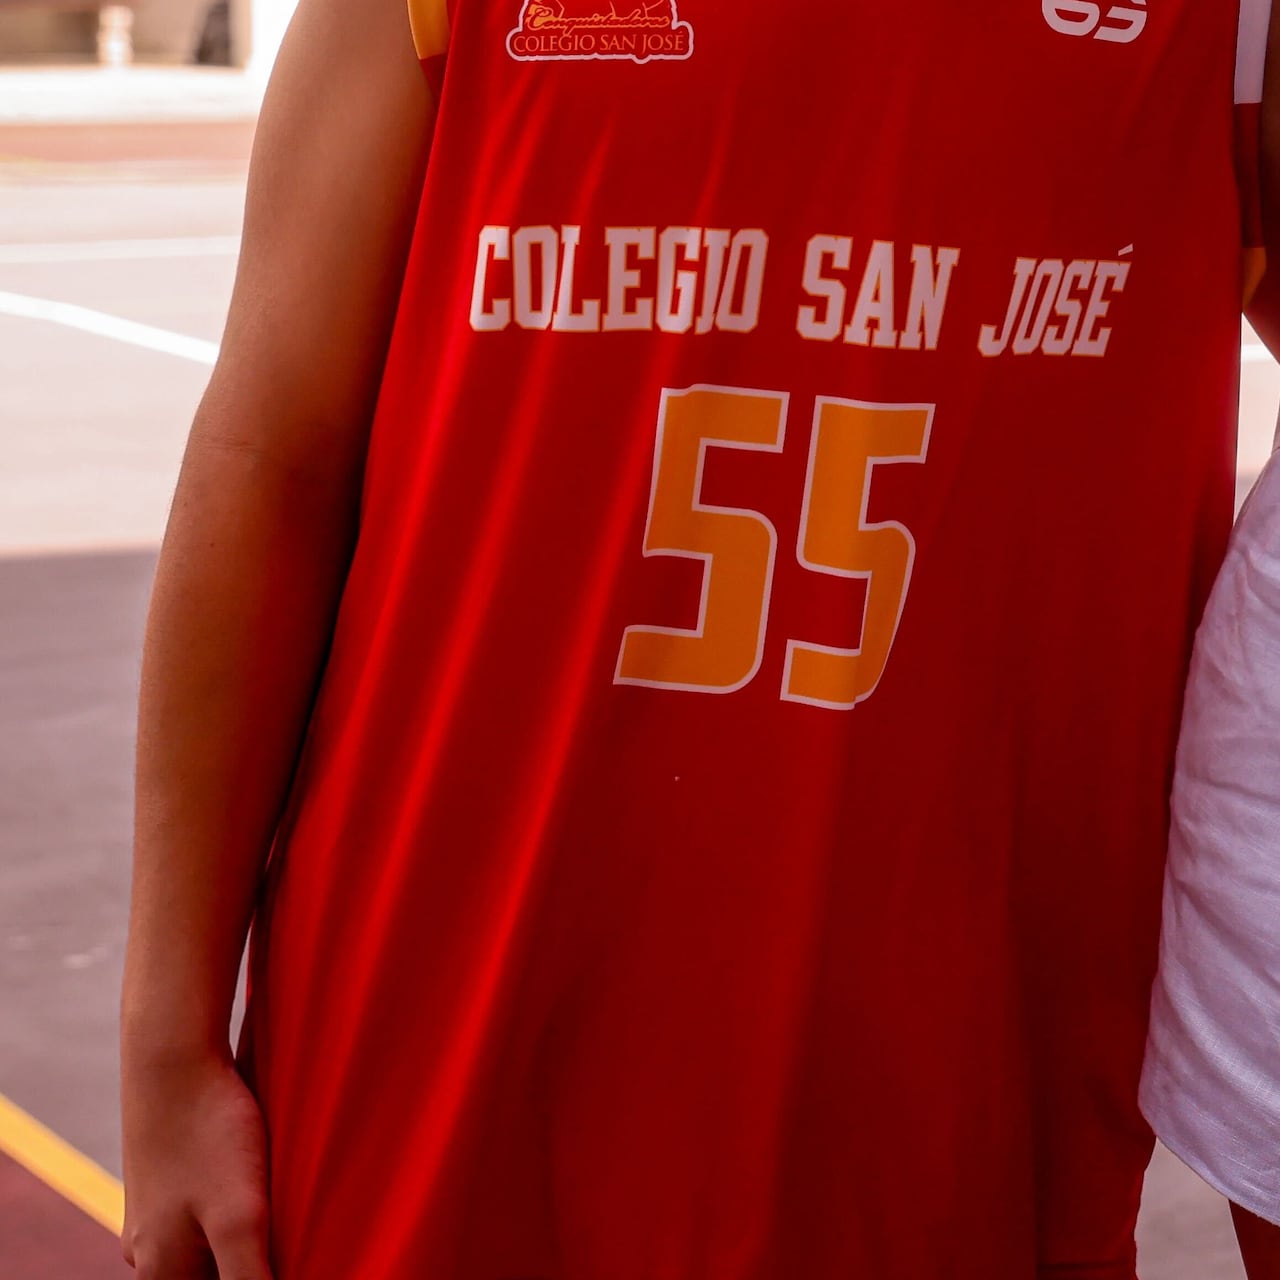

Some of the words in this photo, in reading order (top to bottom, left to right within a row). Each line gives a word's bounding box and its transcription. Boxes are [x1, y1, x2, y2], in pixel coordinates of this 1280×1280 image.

[513, 34, 596, 53] COLEGIO
[599, 34, 637, 51] SAN
[640, 30, 685, 54] JOSÉ
[469, 224, 770, 335] COLEGIO
[796, 233, 961, 350] SAN
[977, 243, 1134, 357] JOSÉ
[612, 383, 937, 710] 55
